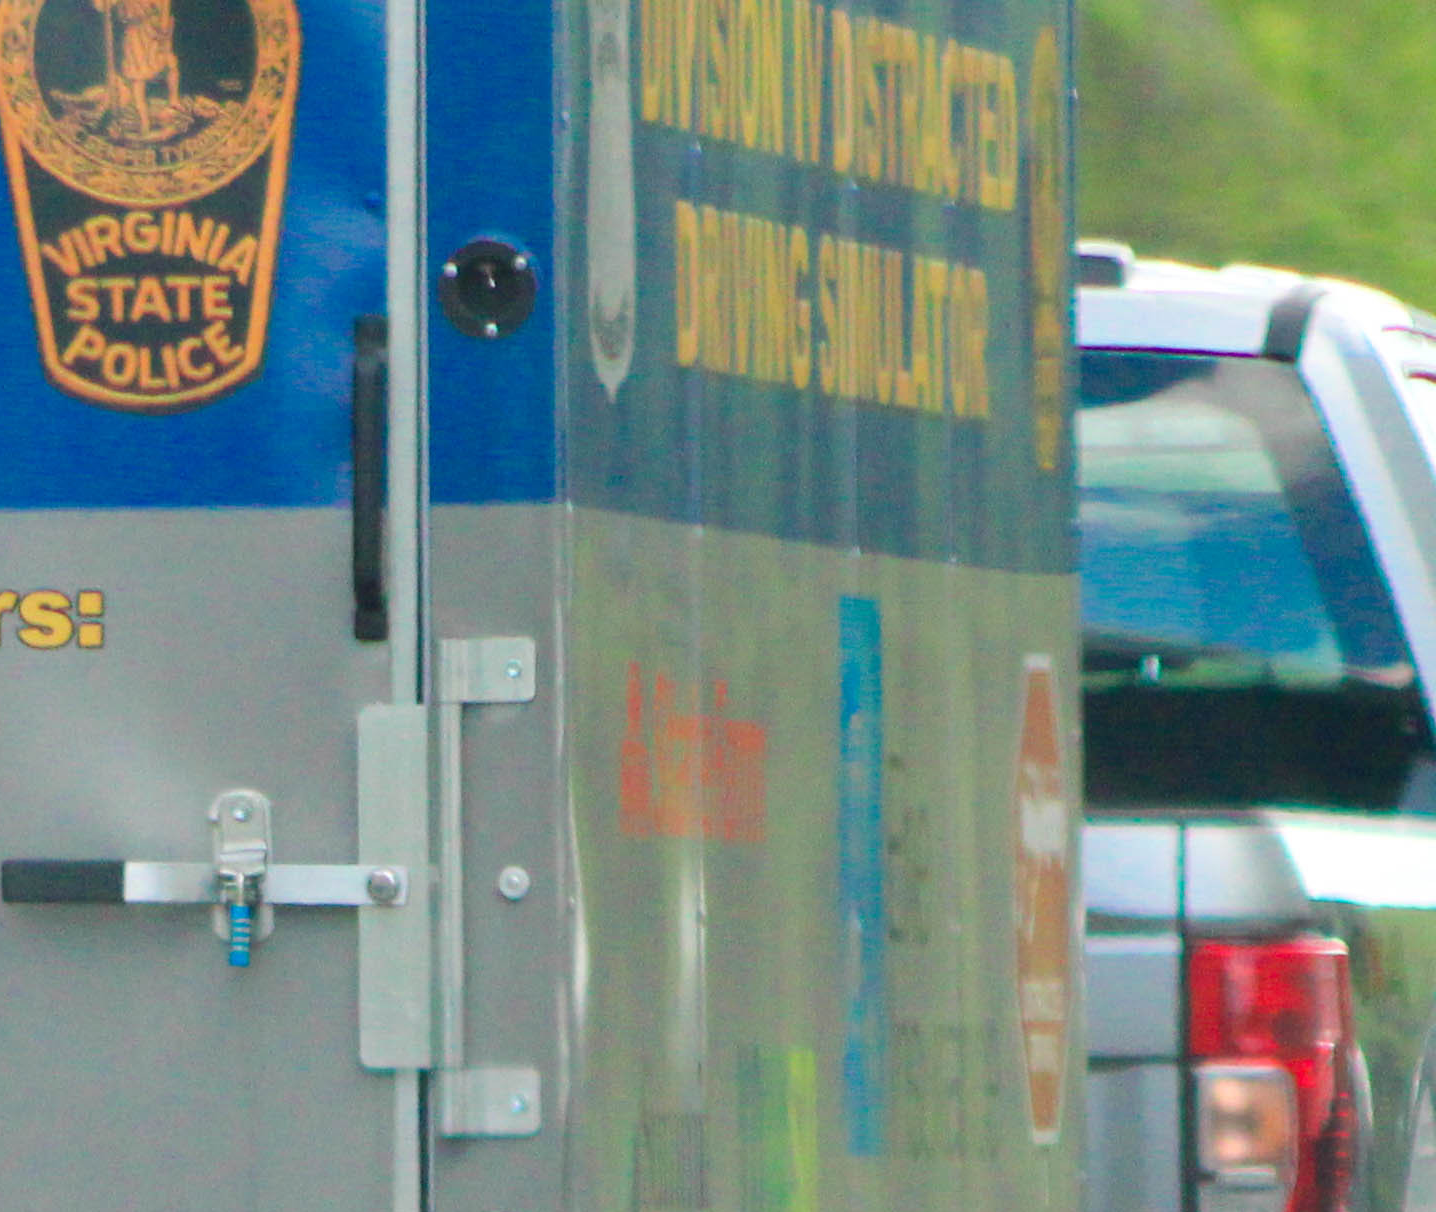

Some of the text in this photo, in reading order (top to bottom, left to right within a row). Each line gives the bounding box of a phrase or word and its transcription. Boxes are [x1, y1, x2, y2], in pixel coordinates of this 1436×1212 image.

[641, 0, 784, 157] DIVISION
[831, 8, 1019, 211] DISTRACTED
[42, 211, 260, 286] VIRGINIA
[65, 275, 235, 325] STATE
[675, 200, 811, 390] DRIVING
[819, 234, 989, 418] SIMULATOR
[64, 321, 245, 389] POLICE
